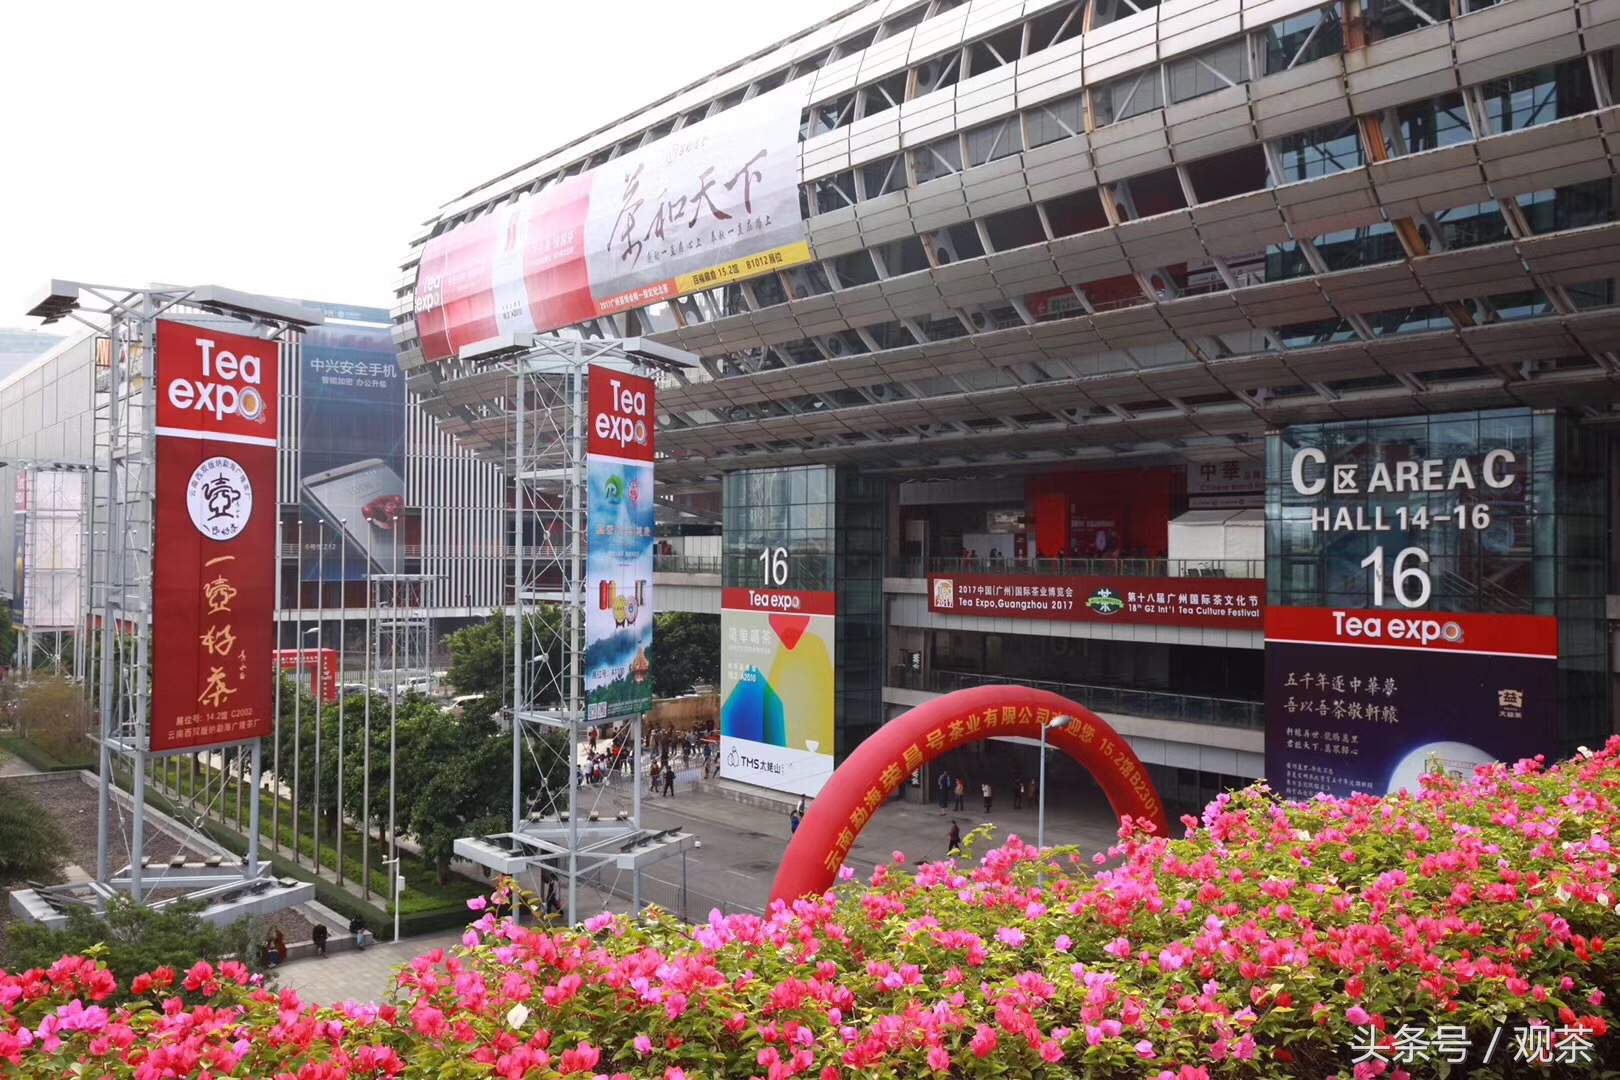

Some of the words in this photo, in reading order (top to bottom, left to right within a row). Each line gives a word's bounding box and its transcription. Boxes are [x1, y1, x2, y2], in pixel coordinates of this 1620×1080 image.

[746, 252, 783, 269] B1012展位
[195, 338, 261, 384] Tea
[310, 358, 397, 378] 中兴安全手机
[168, 378, 265, 421] expo
[609, 379, 645, 416] Tea
[595, 413, 647, 448] expo
[1367, 458, 1476, 493] AREA
[1482, 448, 1516, 489] C
[1311, 506, 1391, 531] HALL
[1395, 503, 1490, 530] 14-16
[760, 546, 788, 585] 16
[1361, 546, 1431, 608] 16
[749, 590, 769, 607] Tea
[770, 593, 801, 611] expo
[958, 585, 1074, 598] 2017中国(广州)国际茶业博览会
[958, 597, 973, 607] Tea
[1051, 600, 1073, 610] 2017
[1127, 592, 1259, 607] 第十八届广州国际茶文化节
[1144, 604, 1155, 613] GZ
[1178, 606, 1194, 615] Tea
[1196, 606, 1226, 616] Culture
[1227, 607, 1260, 618] Festival
[1332, 611, 1381, 637] Tea
[1387, 618, 1464, 645] expo
[1283, 672, 1398, 697] 五千年逐中華夢
[230, 707, 253, 718] C2002
